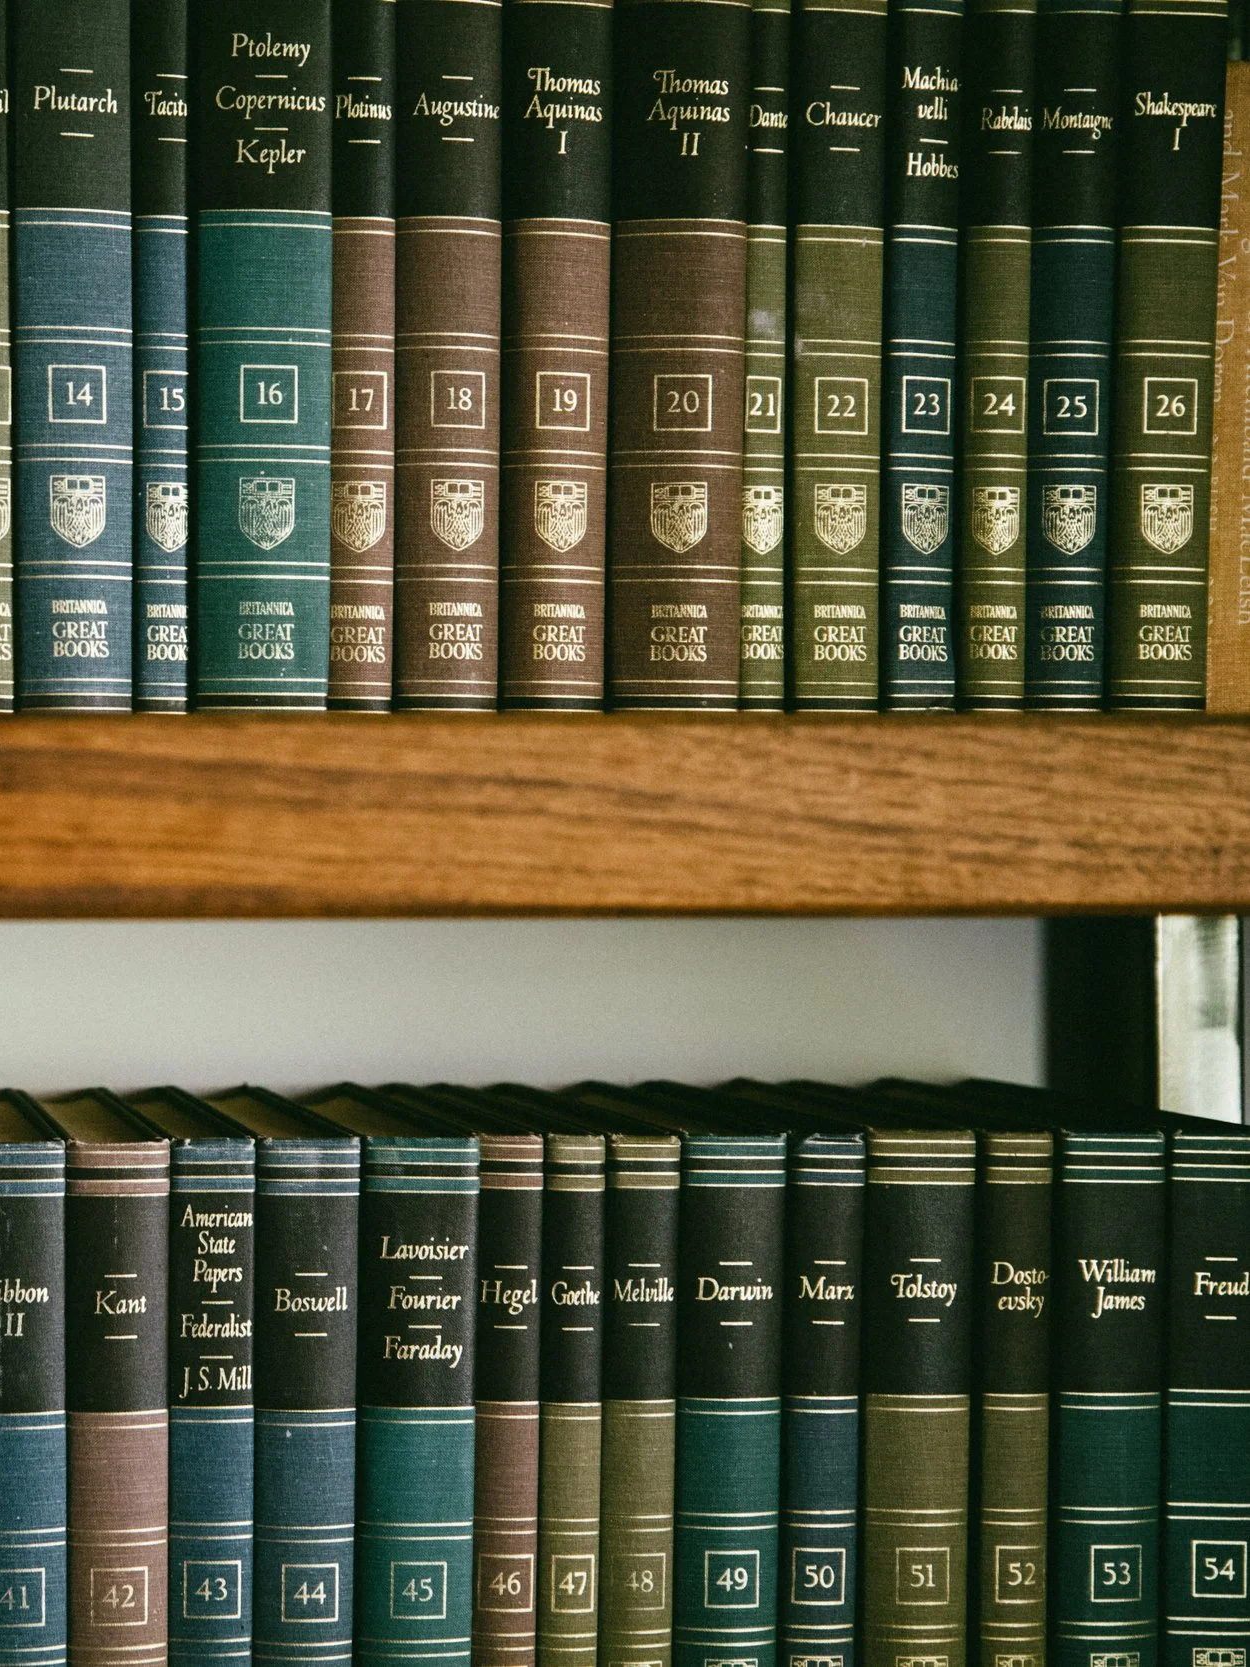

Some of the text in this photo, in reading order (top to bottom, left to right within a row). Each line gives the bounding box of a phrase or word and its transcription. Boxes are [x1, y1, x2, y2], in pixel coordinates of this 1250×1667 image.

[231, 33, 311, 66] Ptolemy
[527, 66, 600, 95] Thomas
[653, 69, 729, 96] Thomas
[33, 86, 118, 114] Plutarch
[216, 85, 326, 119] Copernicus
[336, 94, 392, 120] Plotinus
[414, 93, 500, 126] Augustine
[524, 96, 603, 128] Aquinas
[917, 97, 948, 121] velli
[1134, 92, 1217, 126] Shakespeare
[648, 98, 730, 130] Aquinas
[750, 104, 788, 129] Dante
[806, 102, 882, 128] Chaucer
[980, 106, 1032, 131] Rabelais
[1042, 107, 1113, 140] Montaigne
[558, 131, 568, 154] I
[680, 132, 700, 156] II
[1173, 128, 1180, 150] I
[235, 140, 305, 174] Kepler
[907, 152, 958, 179] Hobbes
[65, 382, 93, 406] 14
[160, 387, 185, 411] 15
[257, 381, 283, 405] 16
[348, 388, 374, 411] 17
[446, 386, 472, 410] 18
[552, 388, 577, 411] 19
[666, 390, 700, 413] 20
[750, 392, 776, 416] 21
[914, 392, 940, 415] 23
[983, 393, 1016, 416] 24
[827, 394, 856, 417] 22
[1056, 395, 1088, 418] 25
[1156, 394, 1186, 418] 26
[52, 600, 108, 614] BRITANNICA
[429, 602, 482, 617] BRITANNICA
[900, 605, 946, 619] BRITANNICA
[1139, 605, 1192, 618] BRITANNICA
[52, 620, 108, 638] GREAT
[429, 624, 482, 642] GREAT
[900, 626, 946, 643] GREAT
[1139, 625, 1192, 642] GREAT
[52, 640, 108, 658] BOOKS
[429, 643, 482, 660] BOOKS
[899, 644, 948, 661] BOOKS
[1139, 644, 1192, 660] BOOKS
[180, 1205, 253, 1228] American
[197, 1231, 236, 1254] State
[380, 1235, 468, 1260] Lavoisier
[194, 1259, 243, 1294] Papers
[992, 1261, 1049, 1286] Dosto-
[1079, 1258, 1156, 1283] William
[551, 1281, 600, 1306] Goethe
[614, 1278, 674, 1303] Melville
[696, 1276, 773, 1300] Darwin
[798, 1275, 854, 1302] Marx
[890, 1273, 957, 1306] Tolstoy
[1194, 1271, 1250, 1296] Freud
[94, 1290, 147, 1314] Kant
[275, 1287, 348, 1312] Boswell
[388, 1286, 461, 1311] Fourier
[480, 1278, 538, 1315] Hegel
[998, 1287, 1044, 1318] evsky
[1092, 1286, 1145, 1318] James
[4, 1313, 24, 1337] II
[180, 1313, 252, 1338] Federalist
[384, 1336, 462, 1368] Faraday
[180, 1366, 252, 1399] J. S. Mill
[626, 1570, 654, 1594] 48
[716, 1566, 748, 1590] 49
[804, 1565, 835, 1588] 50
[910, 1565, 935, 1588] 51
[1008, 1563, 1036, 1586] 52
[1104, 1561, 1131, 1585] 53
[1204, 1558, 1235, 1582] 54
[102, 1583, 136, 1608] 42
[196, 1577, 228, 1600] 43
[294, 1582, 327, 1605] 44
[402, 1578, 434, 1602] 45
[488, 1572, 521, 1595] 46
[558, 1572, 587, 1596] 47
[0, 1585, 29, 1610] 41
